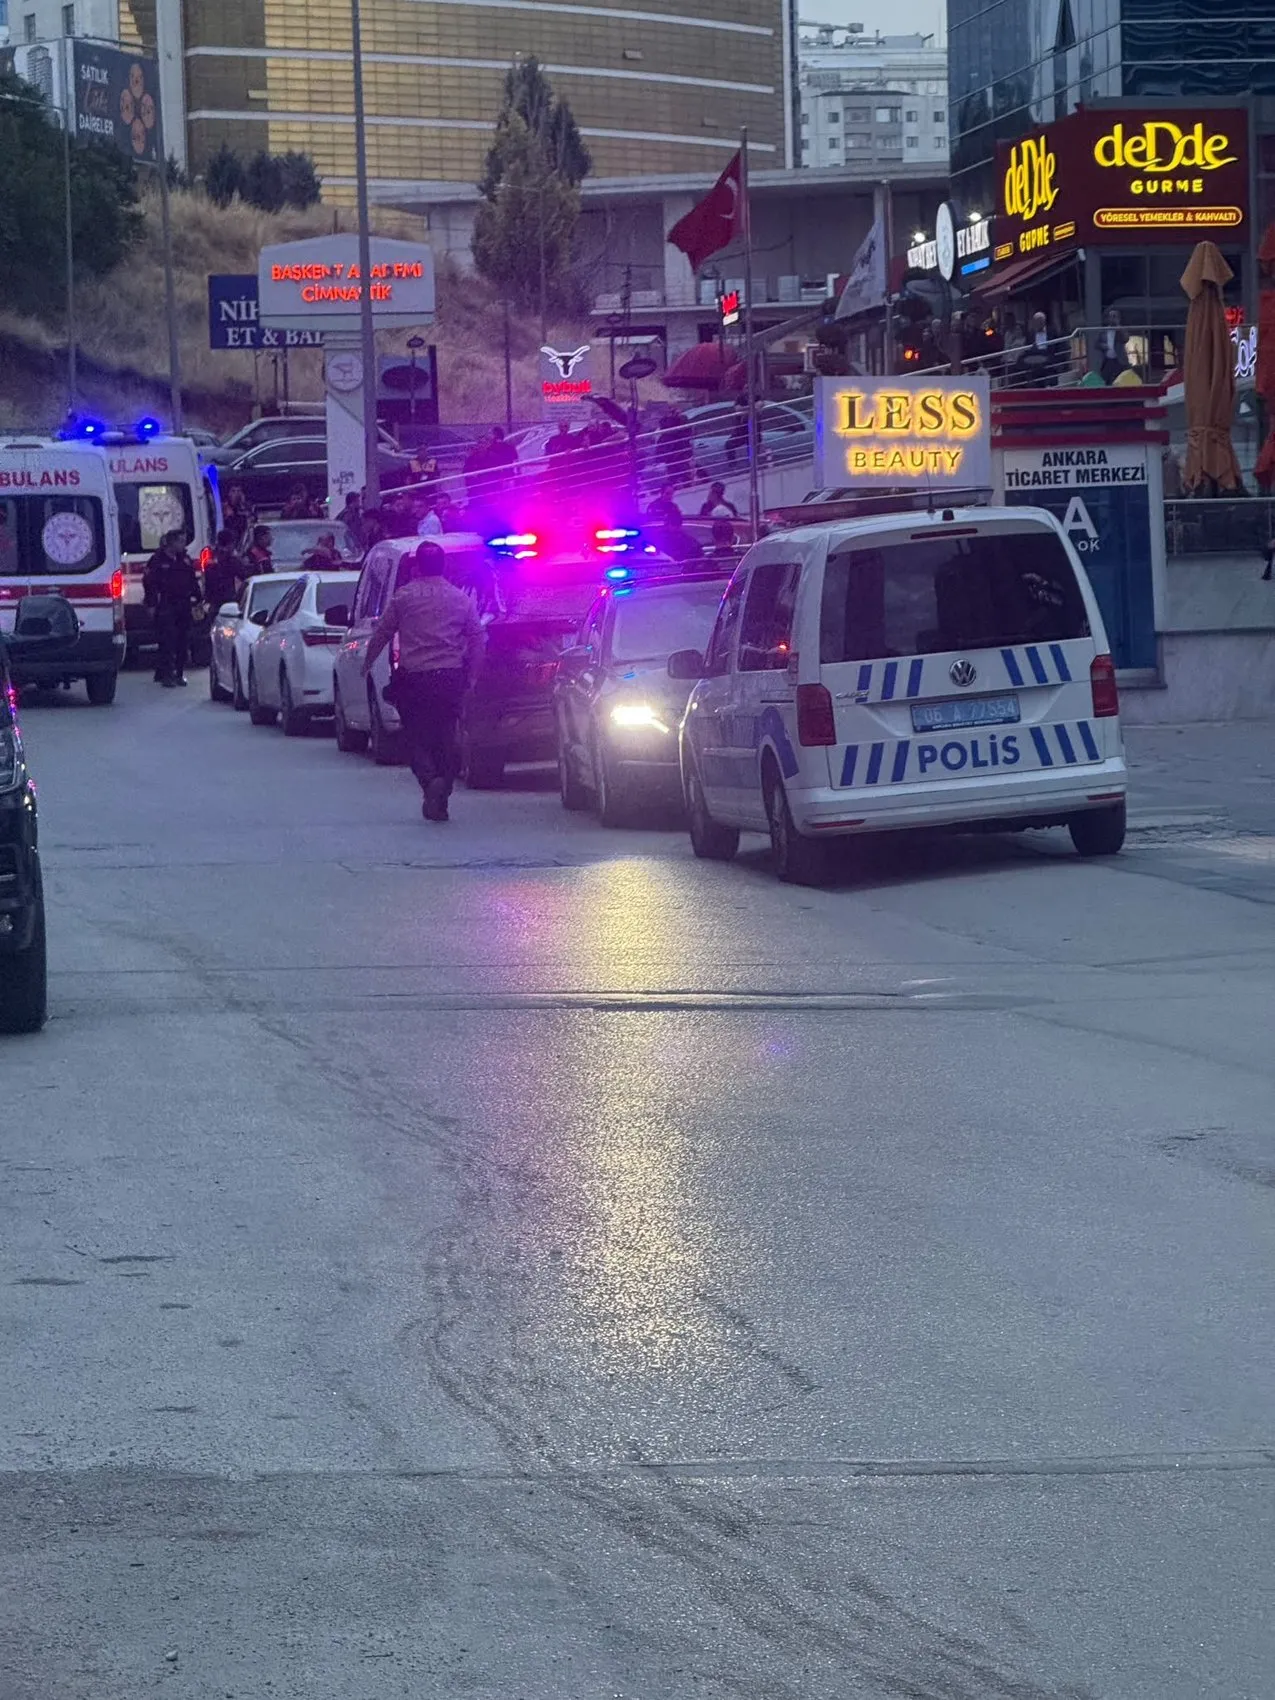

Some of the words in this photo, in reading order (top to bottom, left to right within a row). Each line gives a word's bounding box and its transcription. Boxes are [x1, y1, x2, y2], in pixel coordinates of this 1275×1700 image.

[80, 112, 114, 135] DAİRELER
[1130, 179, 1204, 194] GURME
[1101, 212, 1138, 222] YÖRESEL
[1140, 212, 1184, 222] YEMEKLER
[1195, 211, 1237, 221] KAHVALTI
[347, 260, 424, 279] AADEMİ
[302, 282, 392, 302] CİMNATİK
[227, 327, 256, 346] ET
[262, 328, 279, 345] &
[840, 392, 978, 431] LESS
[853, 450, 961, 468] BEAUTY
[1042, 450, 1109, 467] ANKARA
[1006, 468, 1071, 487] TİCARET
[1075, 463, 1146, 484] MERKEZİ
[1063, 496, 1100, 538] A
